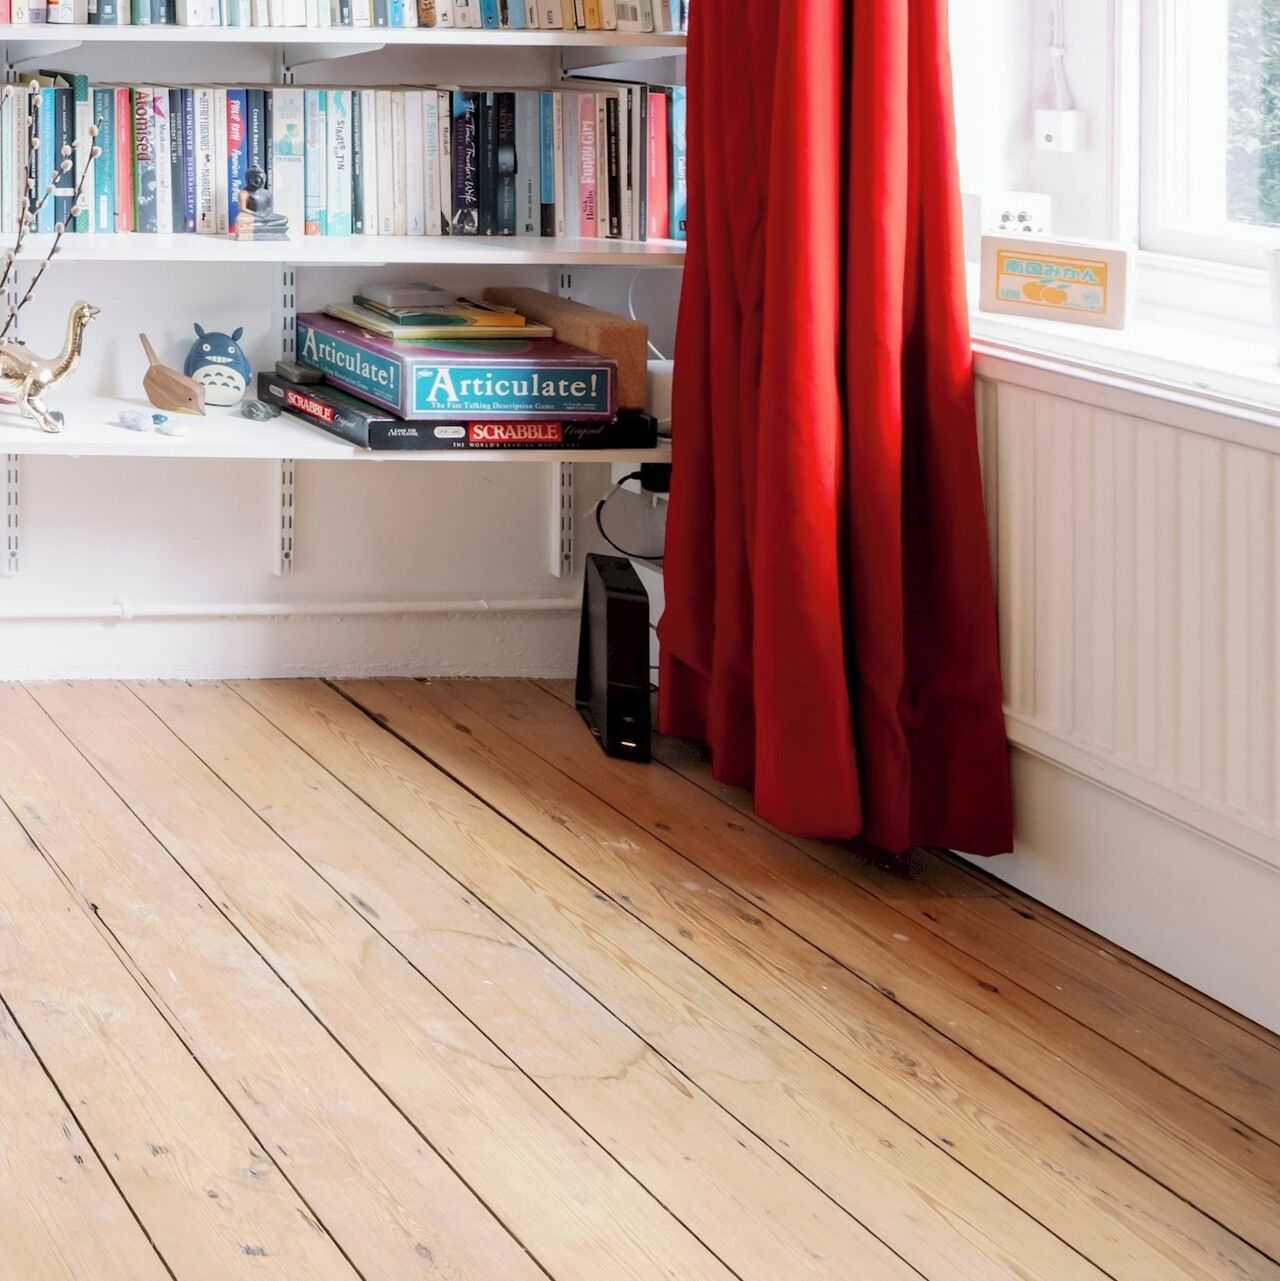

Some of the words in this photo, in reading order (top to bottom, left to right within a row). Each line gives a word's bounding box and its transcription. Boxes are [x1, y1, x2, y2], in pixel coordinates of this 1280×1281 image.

[135, 91, 151, 162] Atomised
[427, 122, 437, 157] Smith
[302, 327, 394, 389] Articulate!
[425, 368, 597, 402] Articulate!
[287, 392, 332, 422] SCRABBLE
[464, 402, 491, 410] Talking
[492, 402, 533, 411] Description
[535, 402, 554, 410] Game
[473, 424, 558, 440] SCRABBLE
